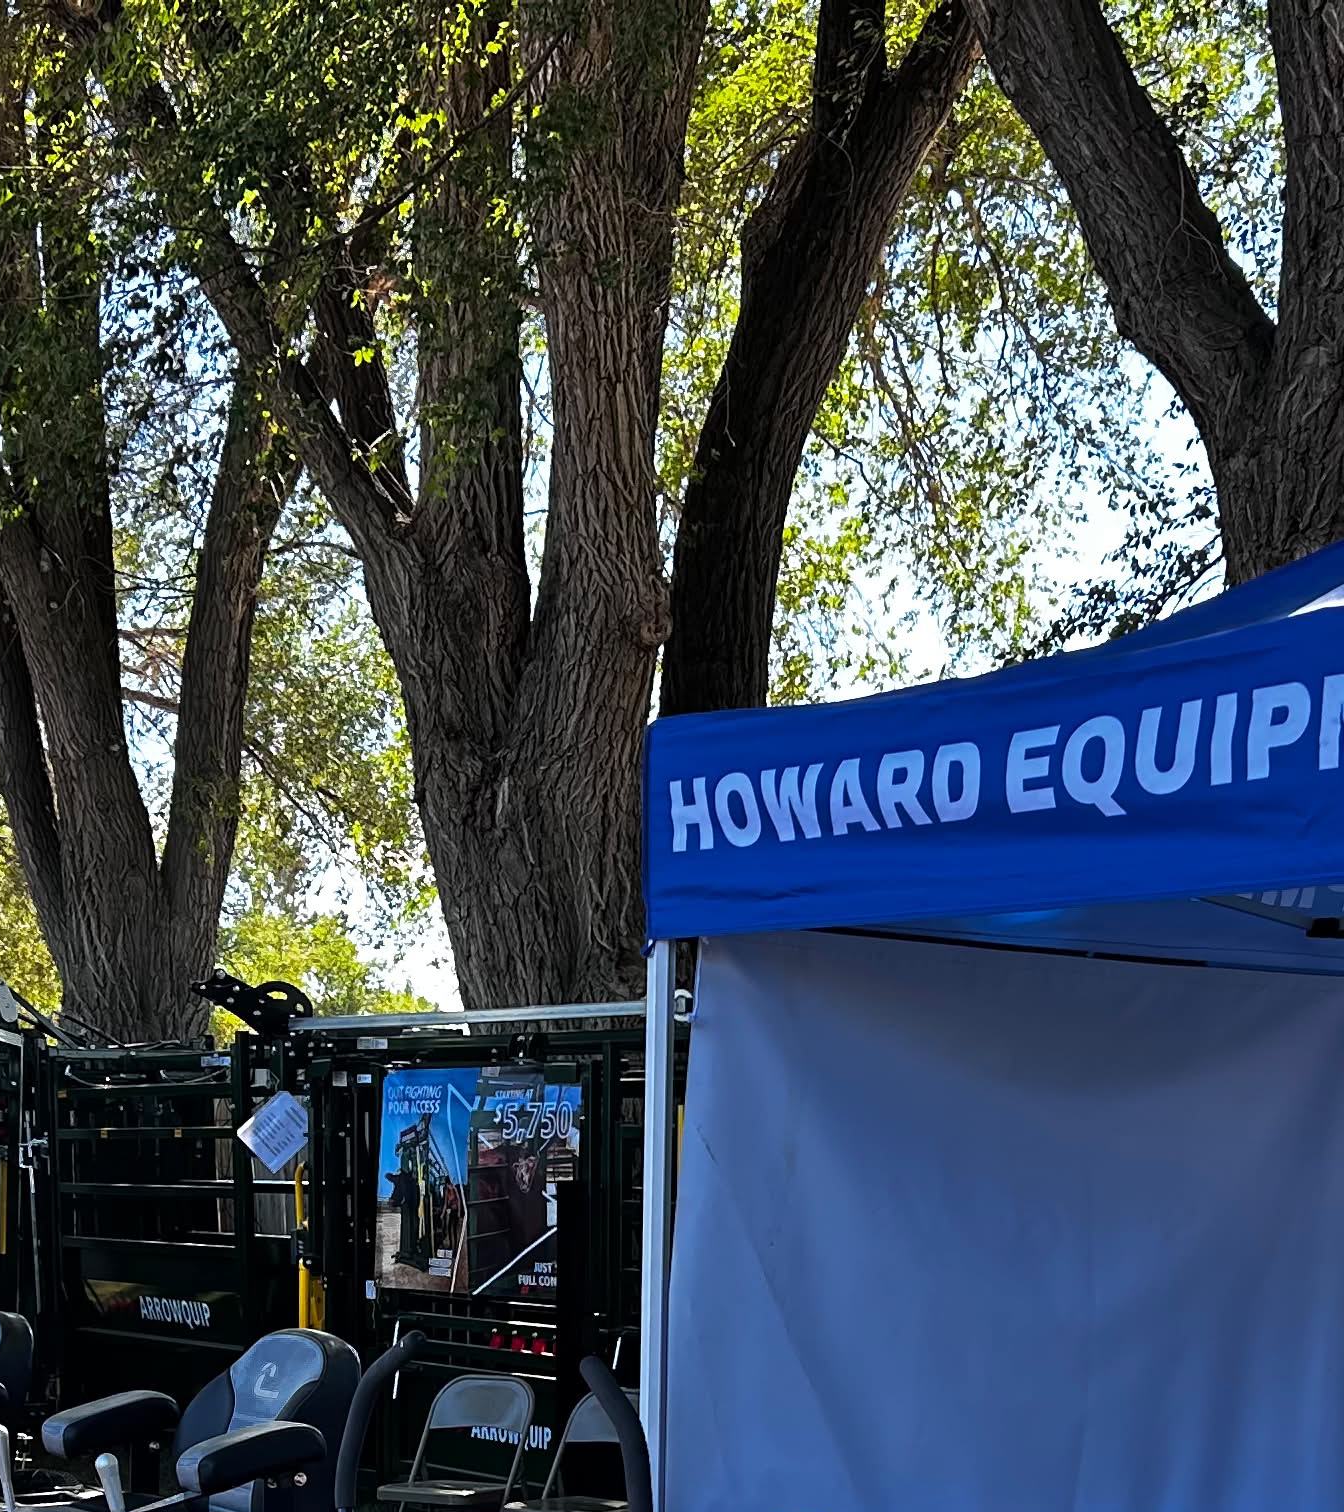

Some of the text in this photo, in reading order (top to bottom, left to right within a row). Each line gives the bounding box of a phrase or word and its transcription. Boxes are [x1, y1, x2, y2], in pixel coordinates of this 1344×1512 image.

[669, 742, 981, 853] HOWARD
[405, 1085, 442, 1099] FIGHTING
[387, 1099, 441, 1114] POOR ACCESS
[493, 1101, 573, 1144] $5,750
[518, 1274, 537, 1286] FULL
[138, 1295, 211, 1330] ARROWQUIP
[470, 1424, 552, 1451] ARROWUIP
